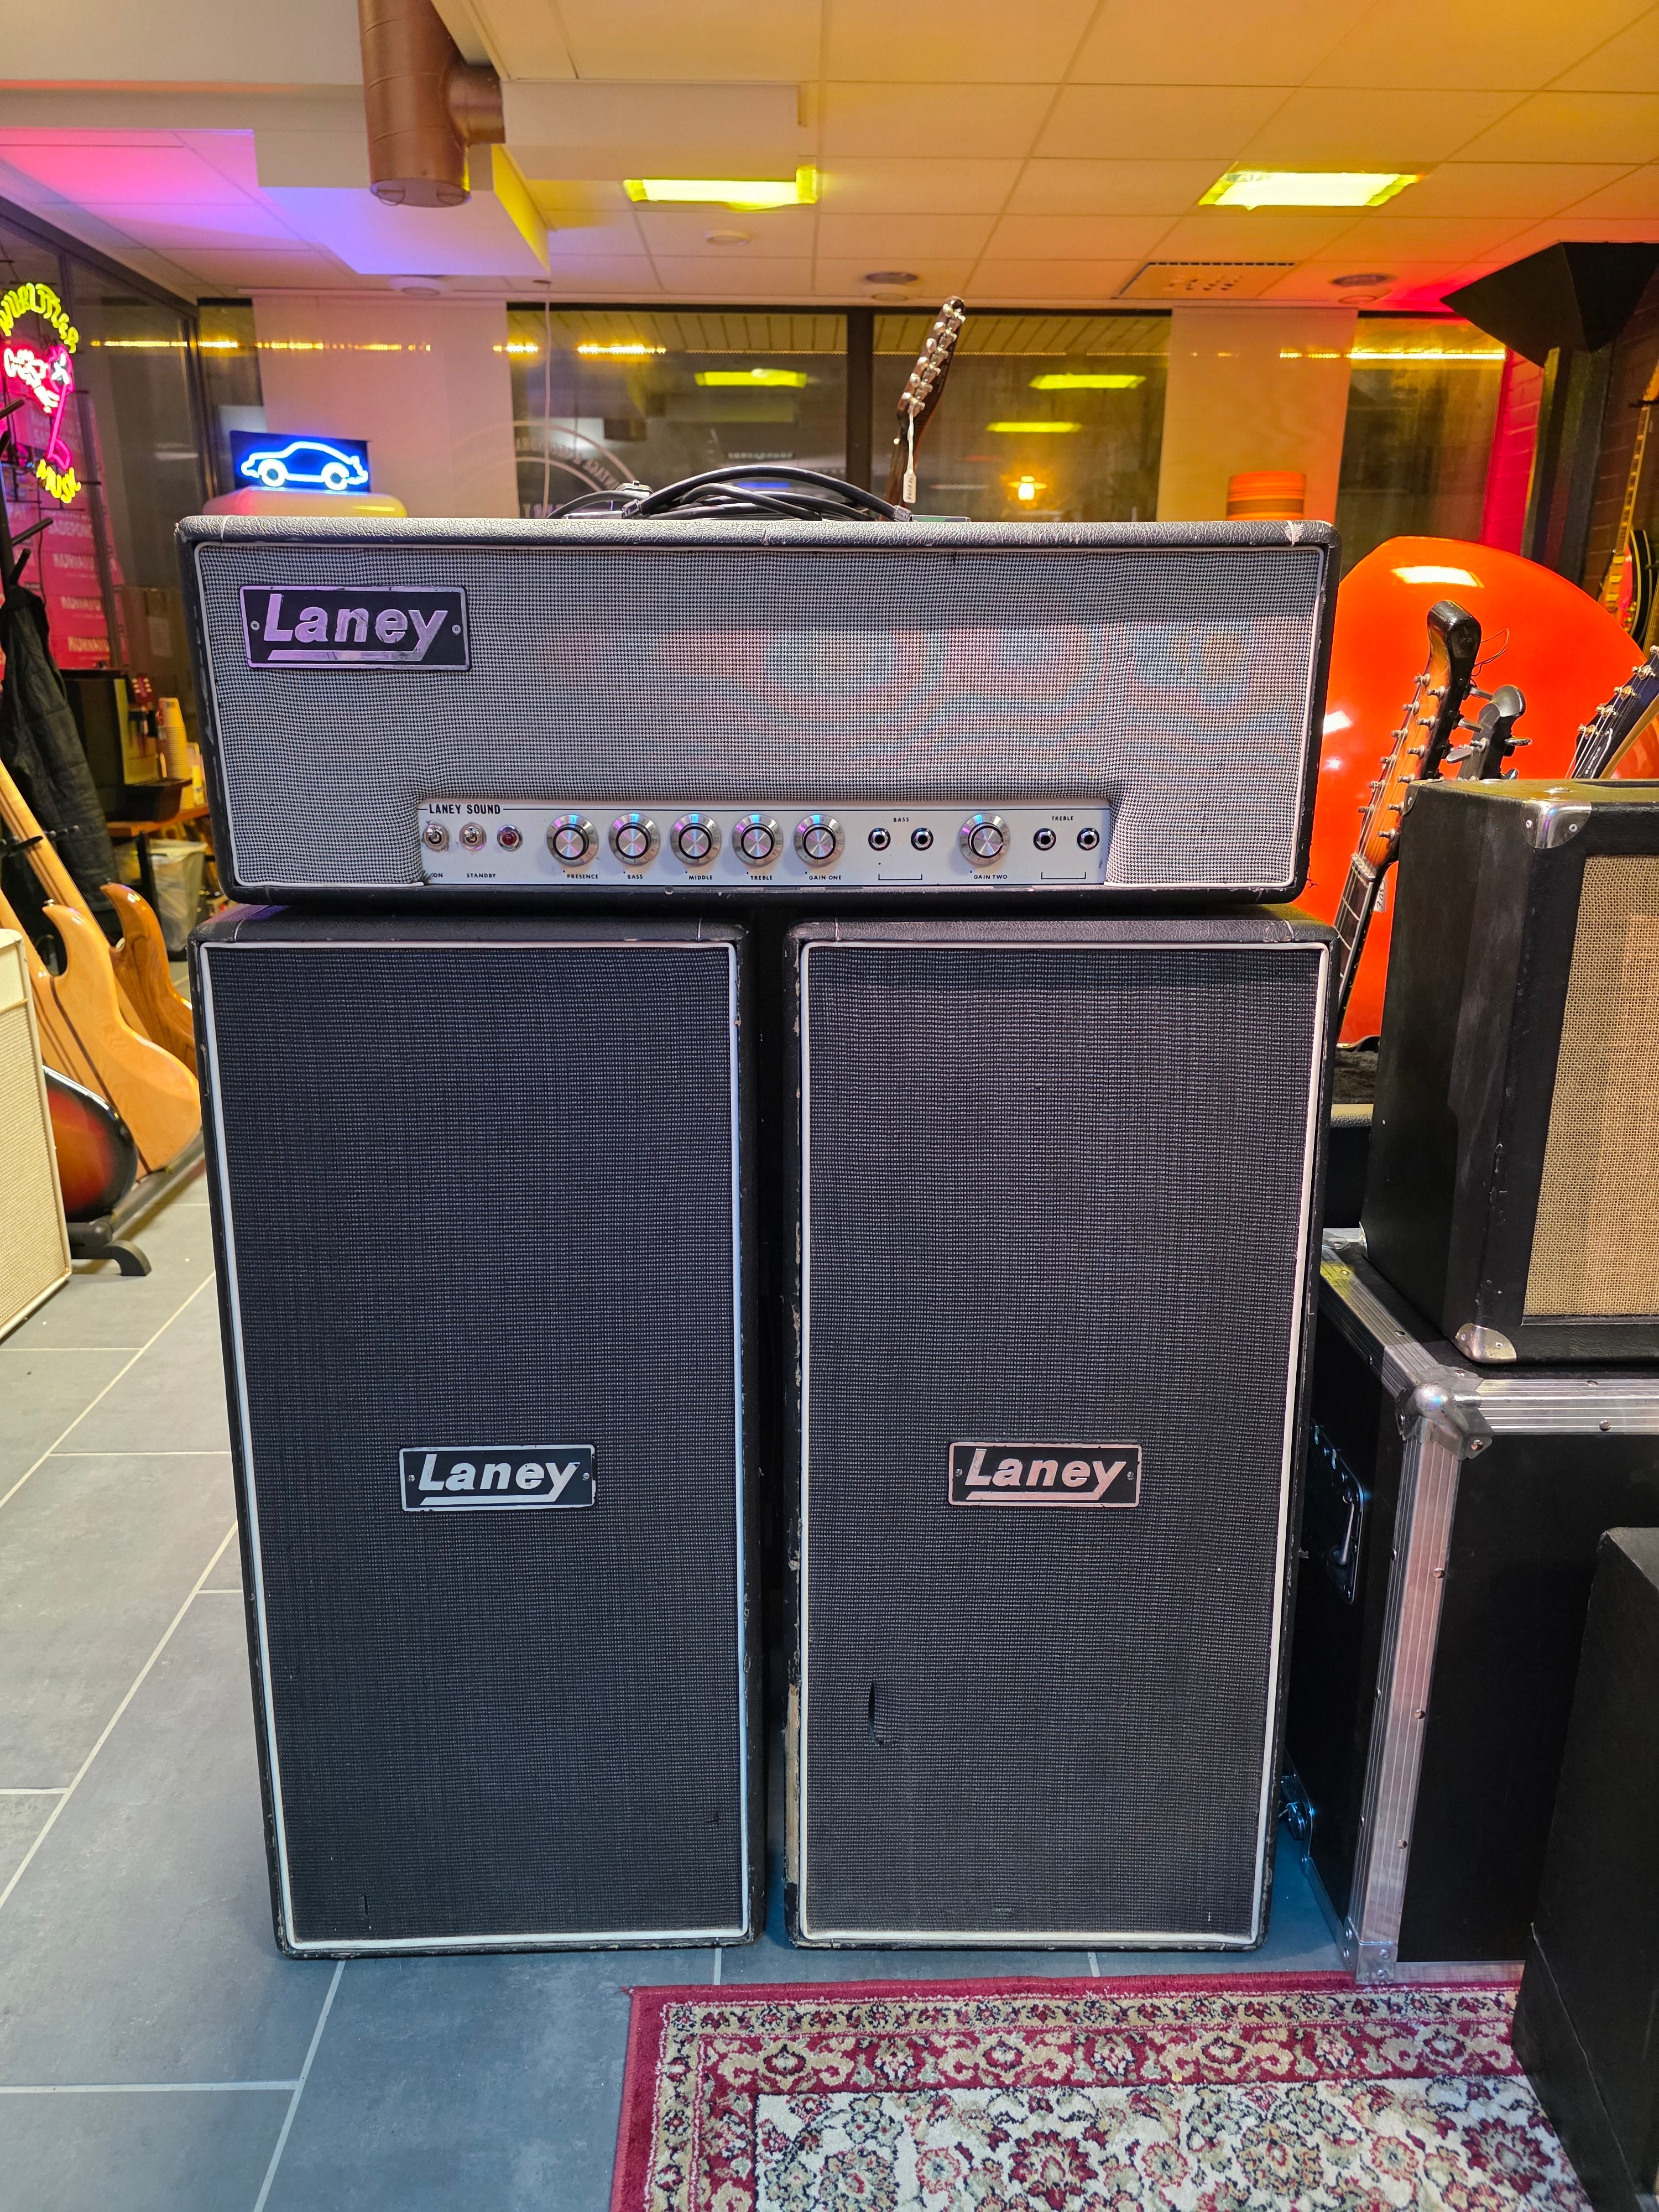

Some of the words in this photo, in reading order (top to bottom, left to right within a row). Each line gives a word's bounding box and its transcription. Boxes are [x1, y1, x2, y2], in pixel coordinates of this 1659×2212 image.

[263, 593, 448, 661] Laney
[429, 804, 461, 814] LANEY
[466, 804, 500, 815] SOUND
[418, 1453, 581, 1505] Laney
[964, 1448, 1127, 1501] Laney
